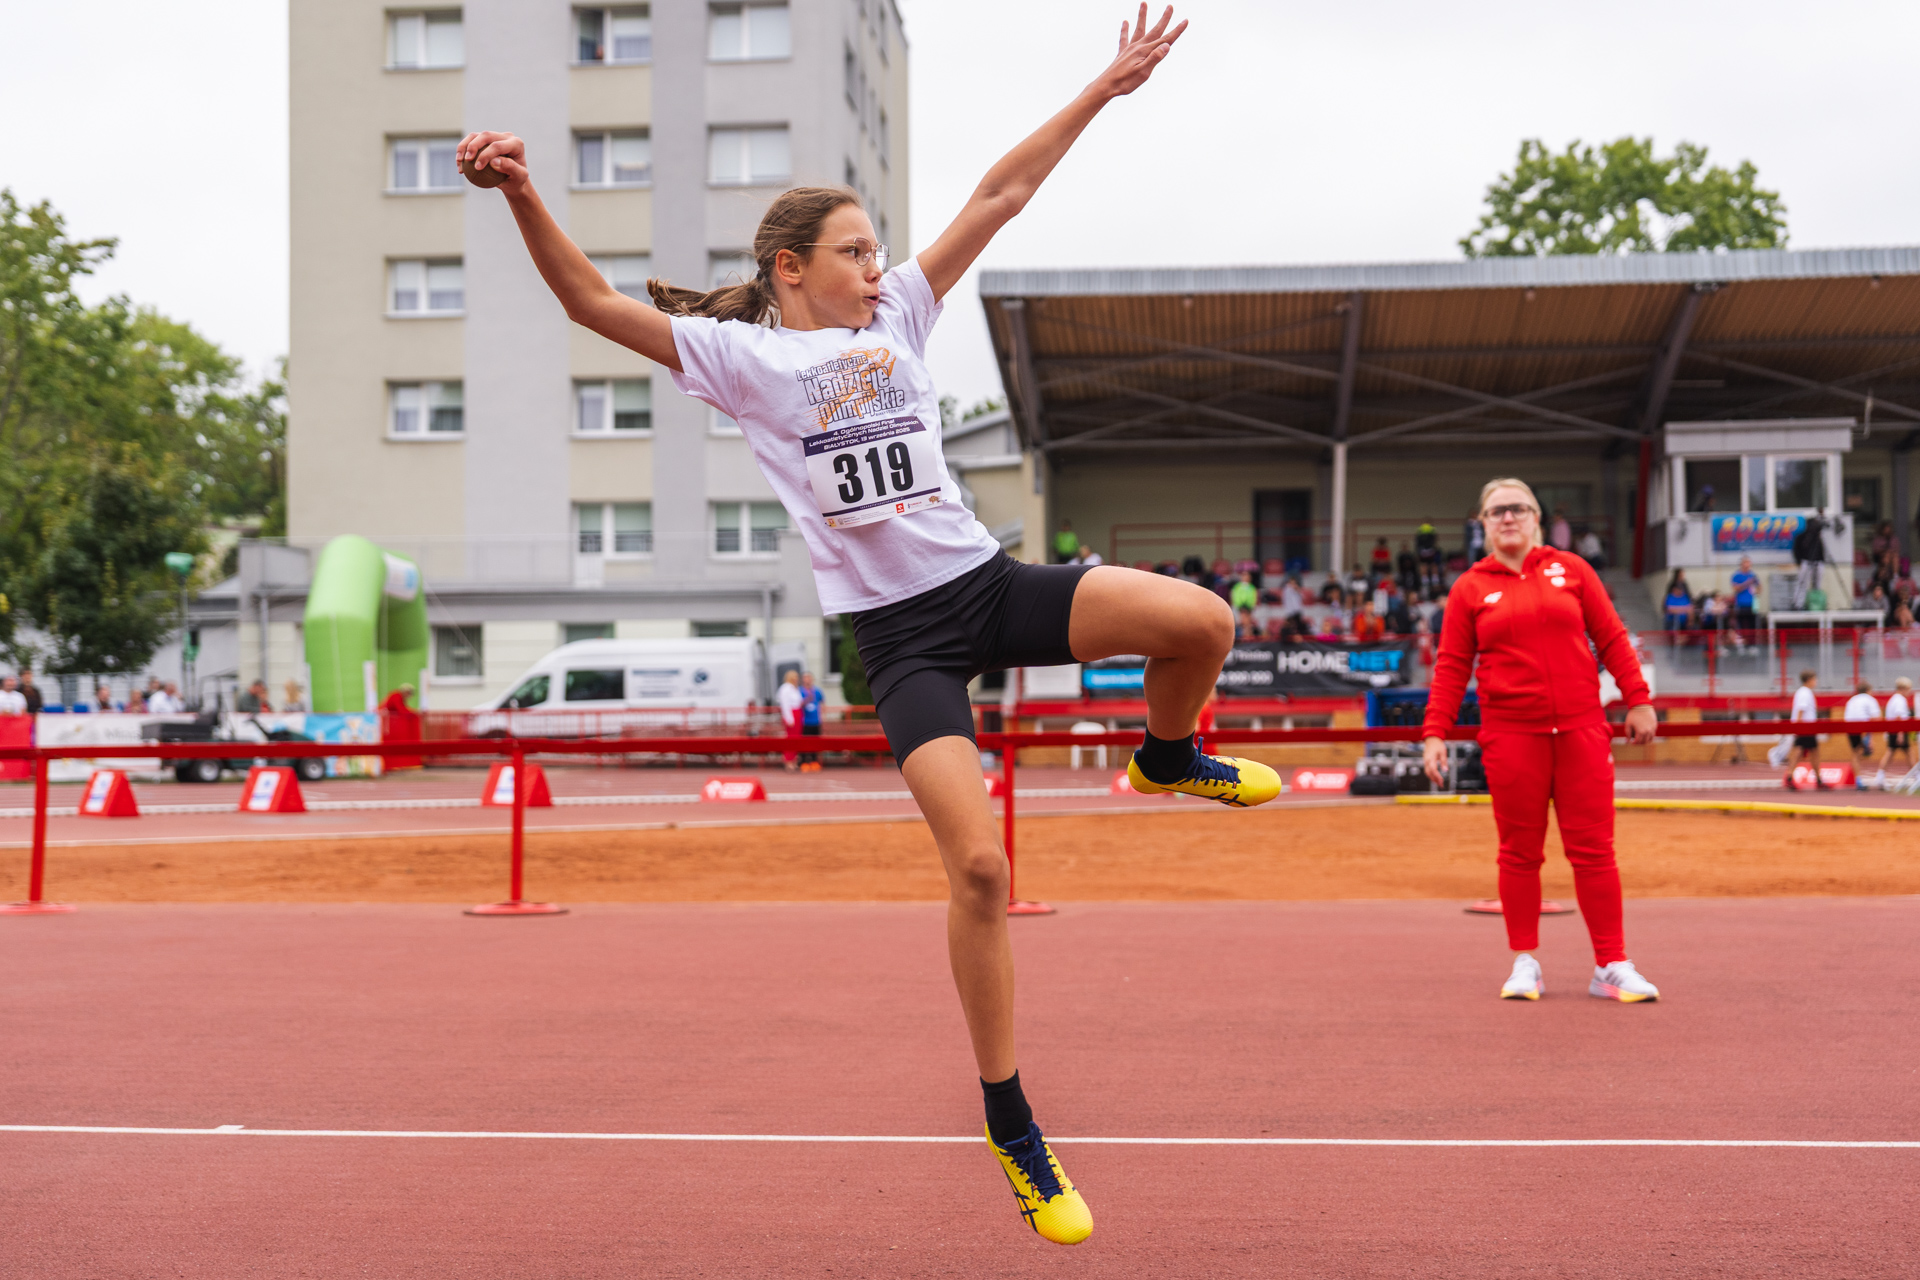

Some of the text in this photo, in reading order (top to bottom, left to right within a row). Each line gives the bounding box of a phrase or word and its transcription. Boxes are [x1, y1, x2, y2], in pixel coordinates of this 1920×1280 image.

[795, 355, 869, 382] Lekkoatletyczne
[803, 363, 890, 406] Nadzieje
[818, 387, 905, 425] Olimpijskie
[808, 420, 919, 447] Lekkoatletycznych Nadziei Olimpijskich
[840, 421, 881, 435] Ogólnopolski
[895, 426, 911, 435] 2025
[832, 441, 915, 505] 319
[1277, 650, 1405, 674] HOMENET
